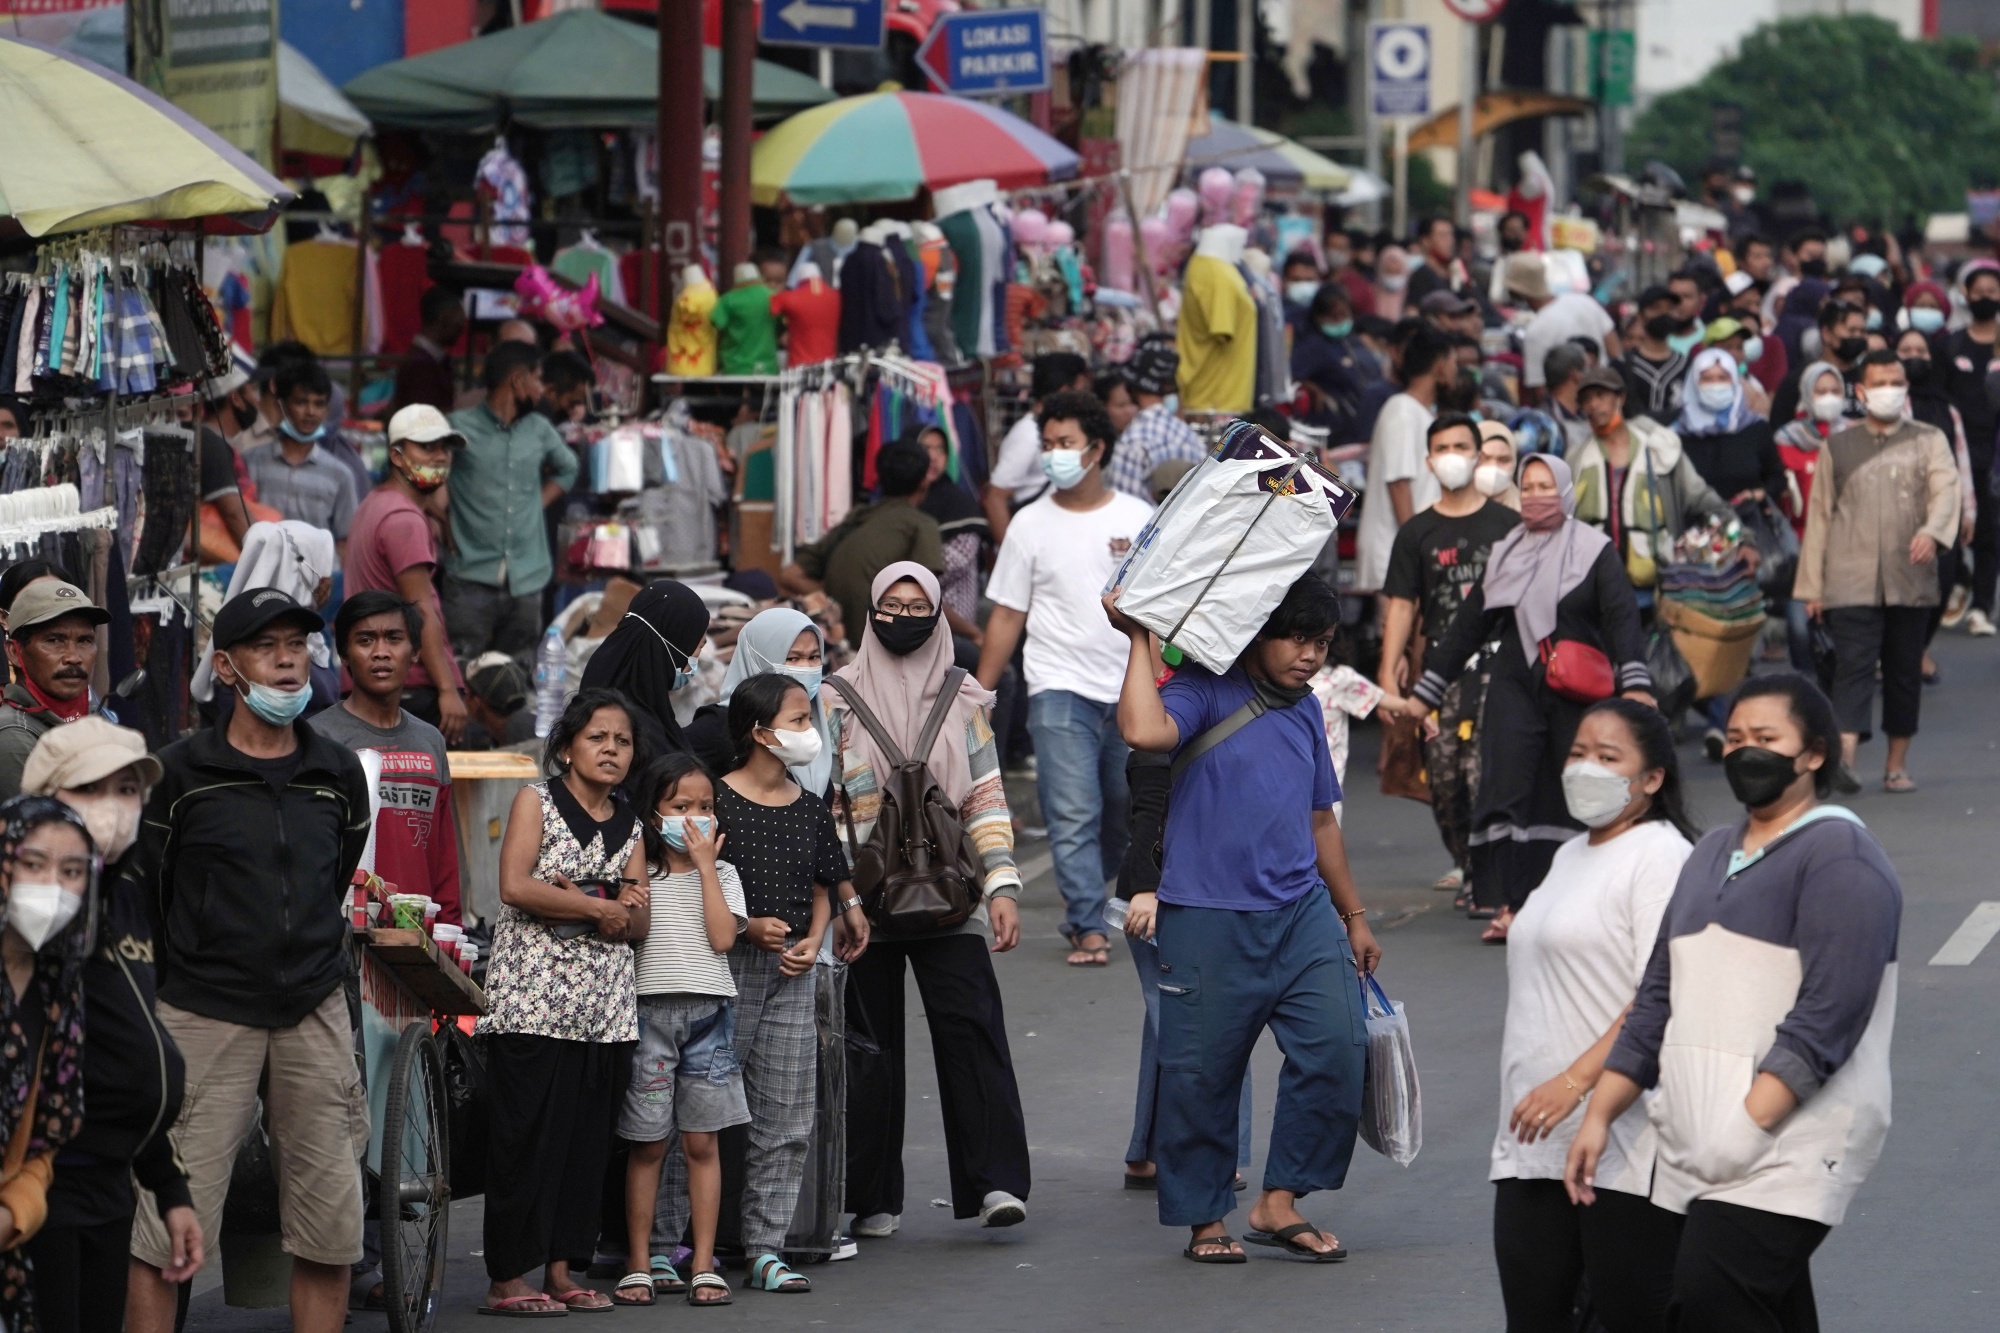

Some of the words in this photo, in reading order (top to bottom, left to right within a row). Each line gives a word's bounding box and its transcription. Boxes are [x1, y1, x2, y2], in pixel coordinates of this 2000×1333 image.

[961, 24, 1031, 48] LOKASI
[960, 51, 1038, 77] PARKIR
[1438, 547, 1458, 566] WE
[381, 755, 432, 770] NNING
[379, 786, 431, 807] ASTER
